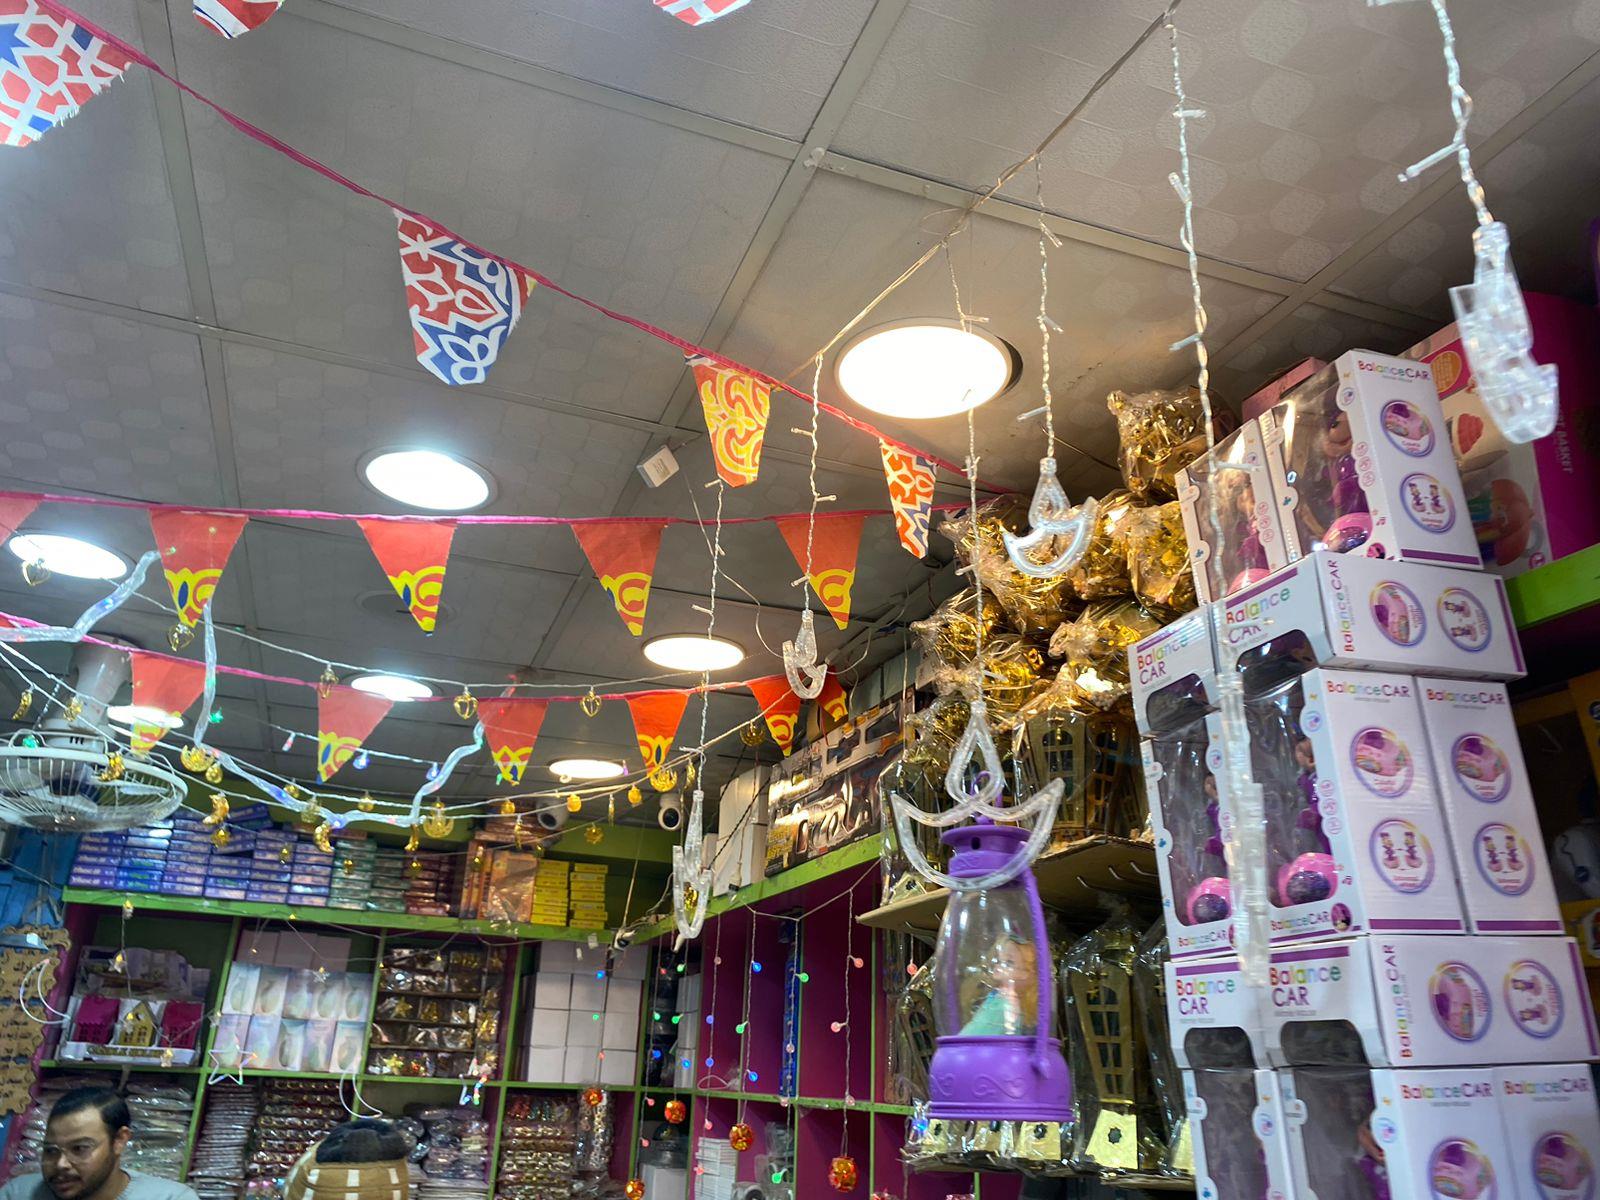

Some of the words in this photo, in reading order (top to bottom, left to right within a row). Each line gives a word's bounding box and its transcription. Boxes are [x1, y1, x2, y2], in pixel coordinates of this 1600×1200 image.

[1226, 587, 1290, 625] Balance
[1227, 624, 1262, 644] CAR
[1136, 634, 1189, 670] Balance
[1139, 661, 1167, 685] CAR
[1326, 680, 1410, 698] BalanceCAR
[1426, 689, 1506, 705] BalanceCAR
[1269, 965, 1342, 986] Balance
[1176, 978, 1236, 996] Balance
[1272, 986, 1310, 1007] CAR
[1178, 996, 1209, 1015] CAR
